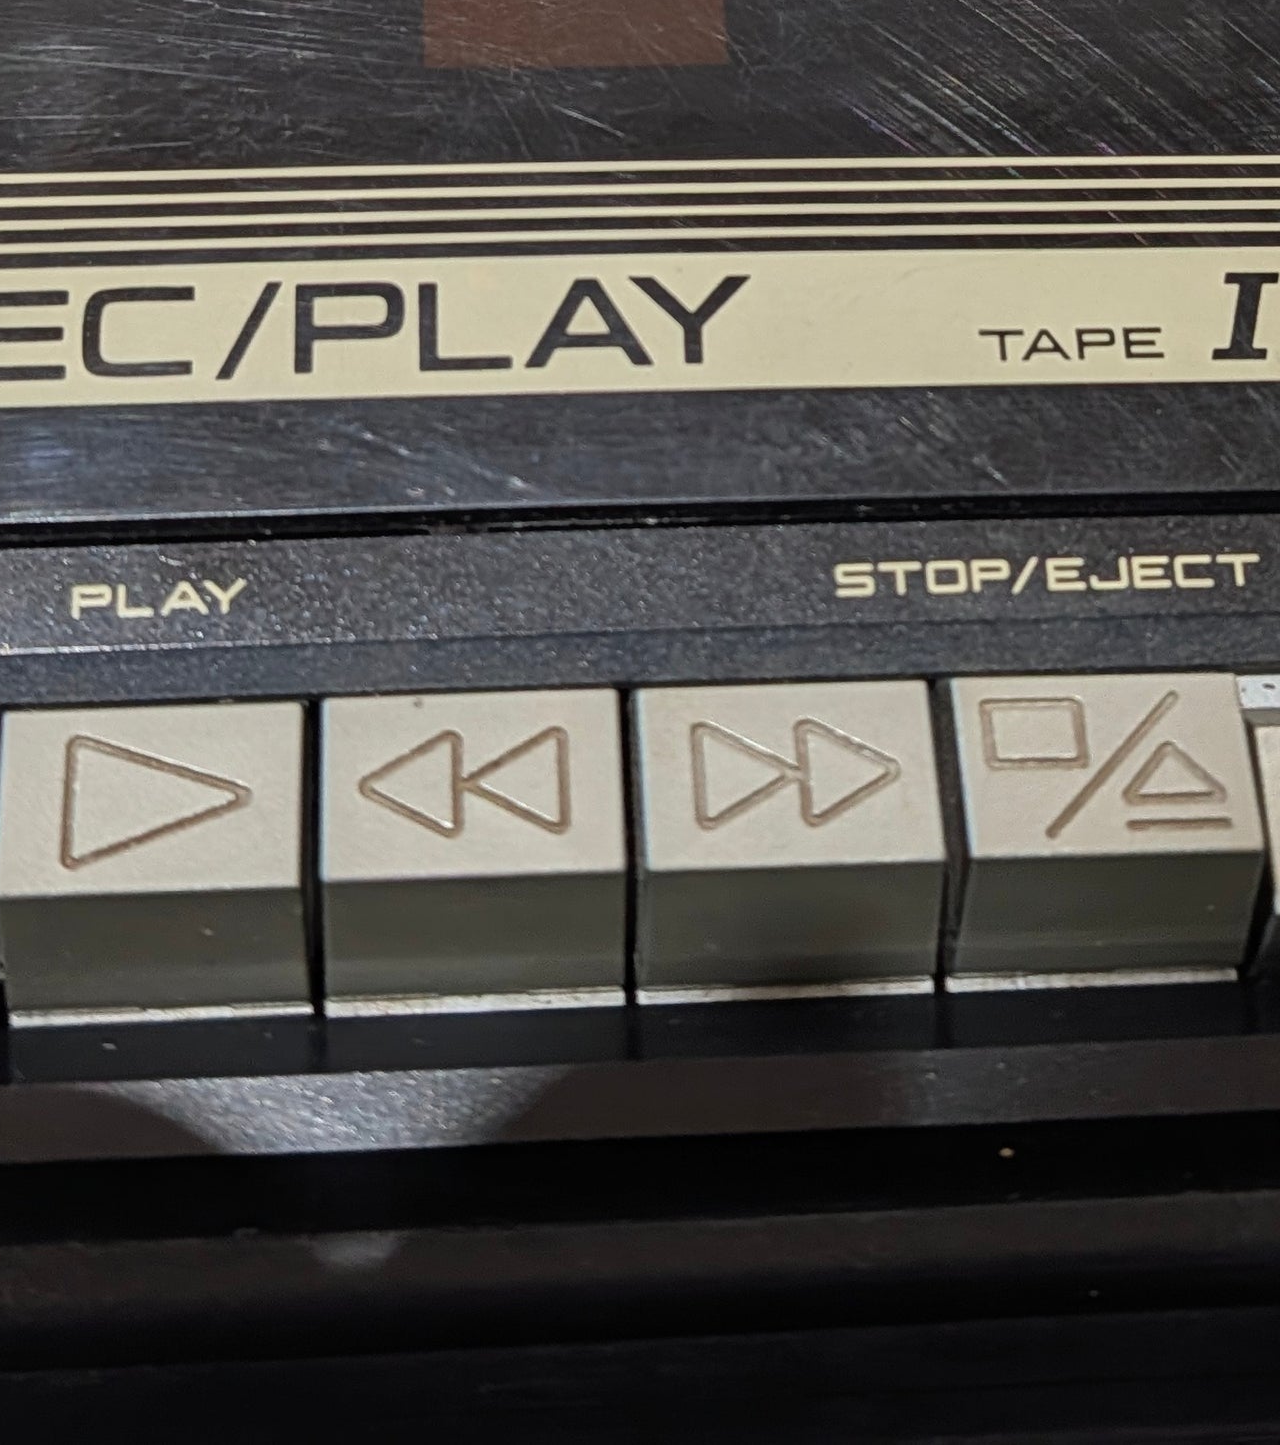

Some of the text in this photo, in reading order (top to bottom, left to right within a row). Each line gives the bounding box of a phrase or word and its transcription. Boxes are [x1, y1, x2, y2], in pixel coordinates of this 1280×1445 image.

[979, 271, 1280, 361] TAPE I
[833, 553, 1260, 598] STOP/EJECT
[69, 578, 248, 621] PLAY
